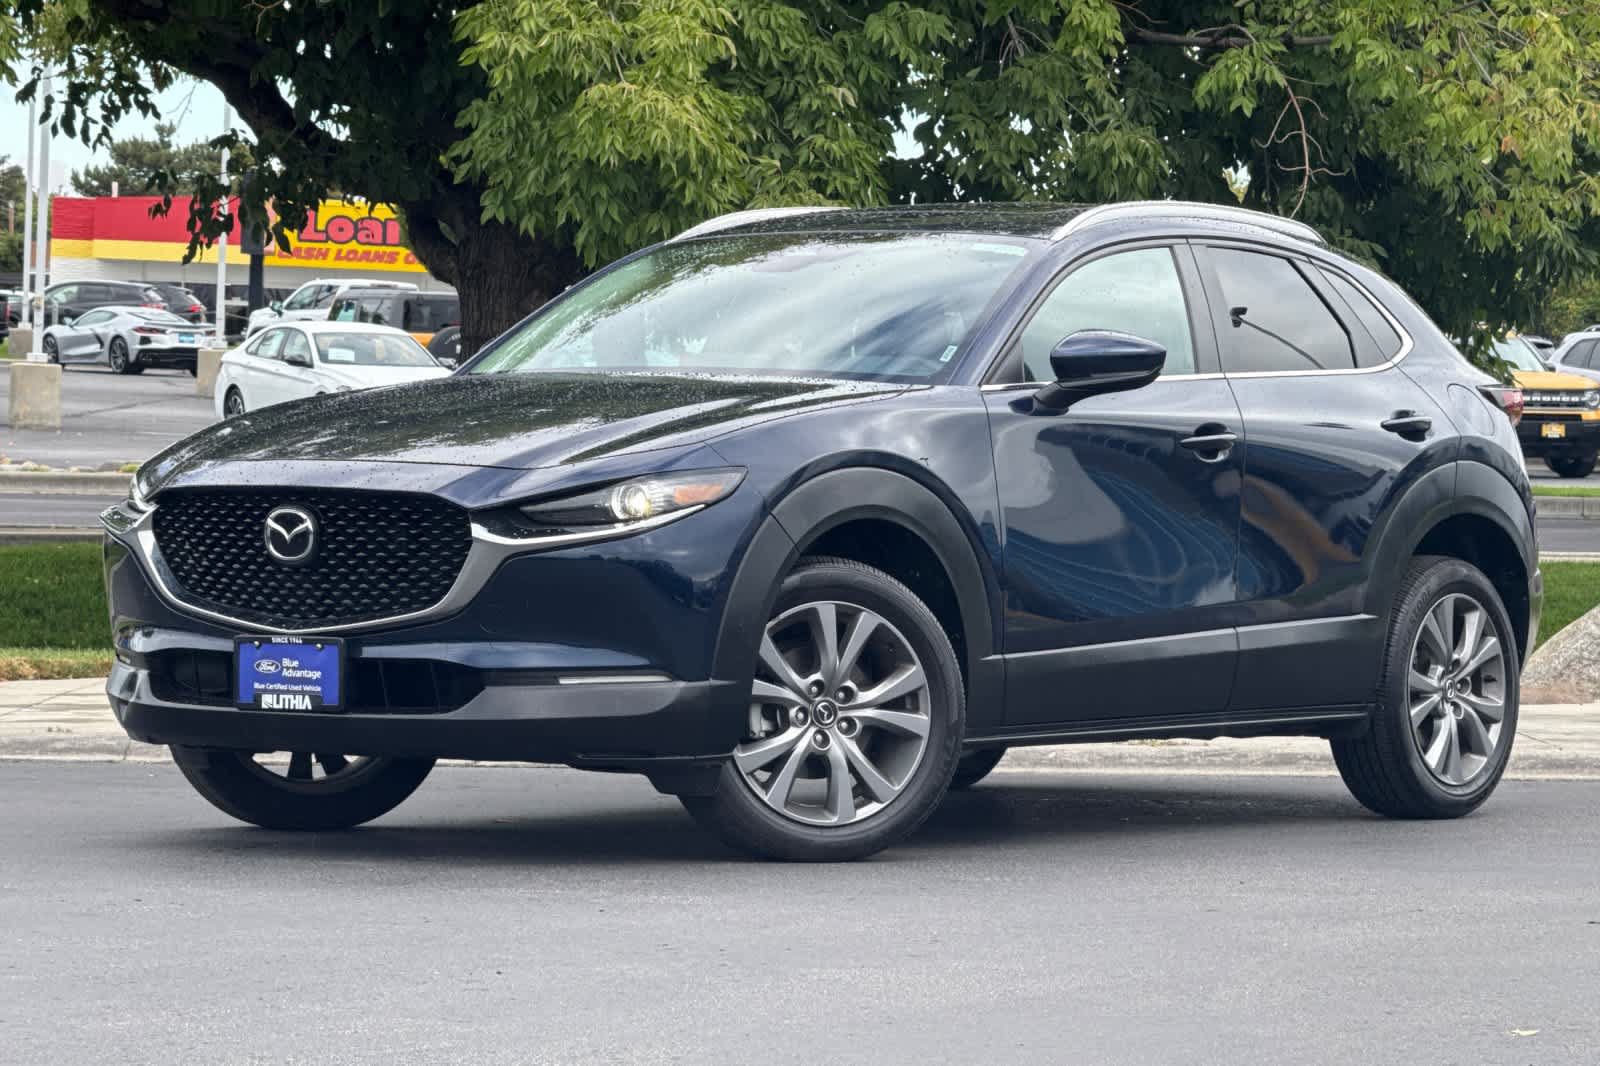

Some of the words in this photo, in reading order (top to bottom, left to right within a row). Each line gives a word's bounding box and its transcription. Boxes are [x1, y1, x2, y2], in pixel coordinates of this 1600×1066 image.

[334, 249, 400, 264] LOANS
[282, 657, 300, 668] Blue
[282, 668, 322, 680] Advantage
[253, 682, 265, 690] Blue
[266, 682, 288, 690] Certified
[303, 684, 321, 692] Vehicle
[272, 694, 312, 710] LITHIA
